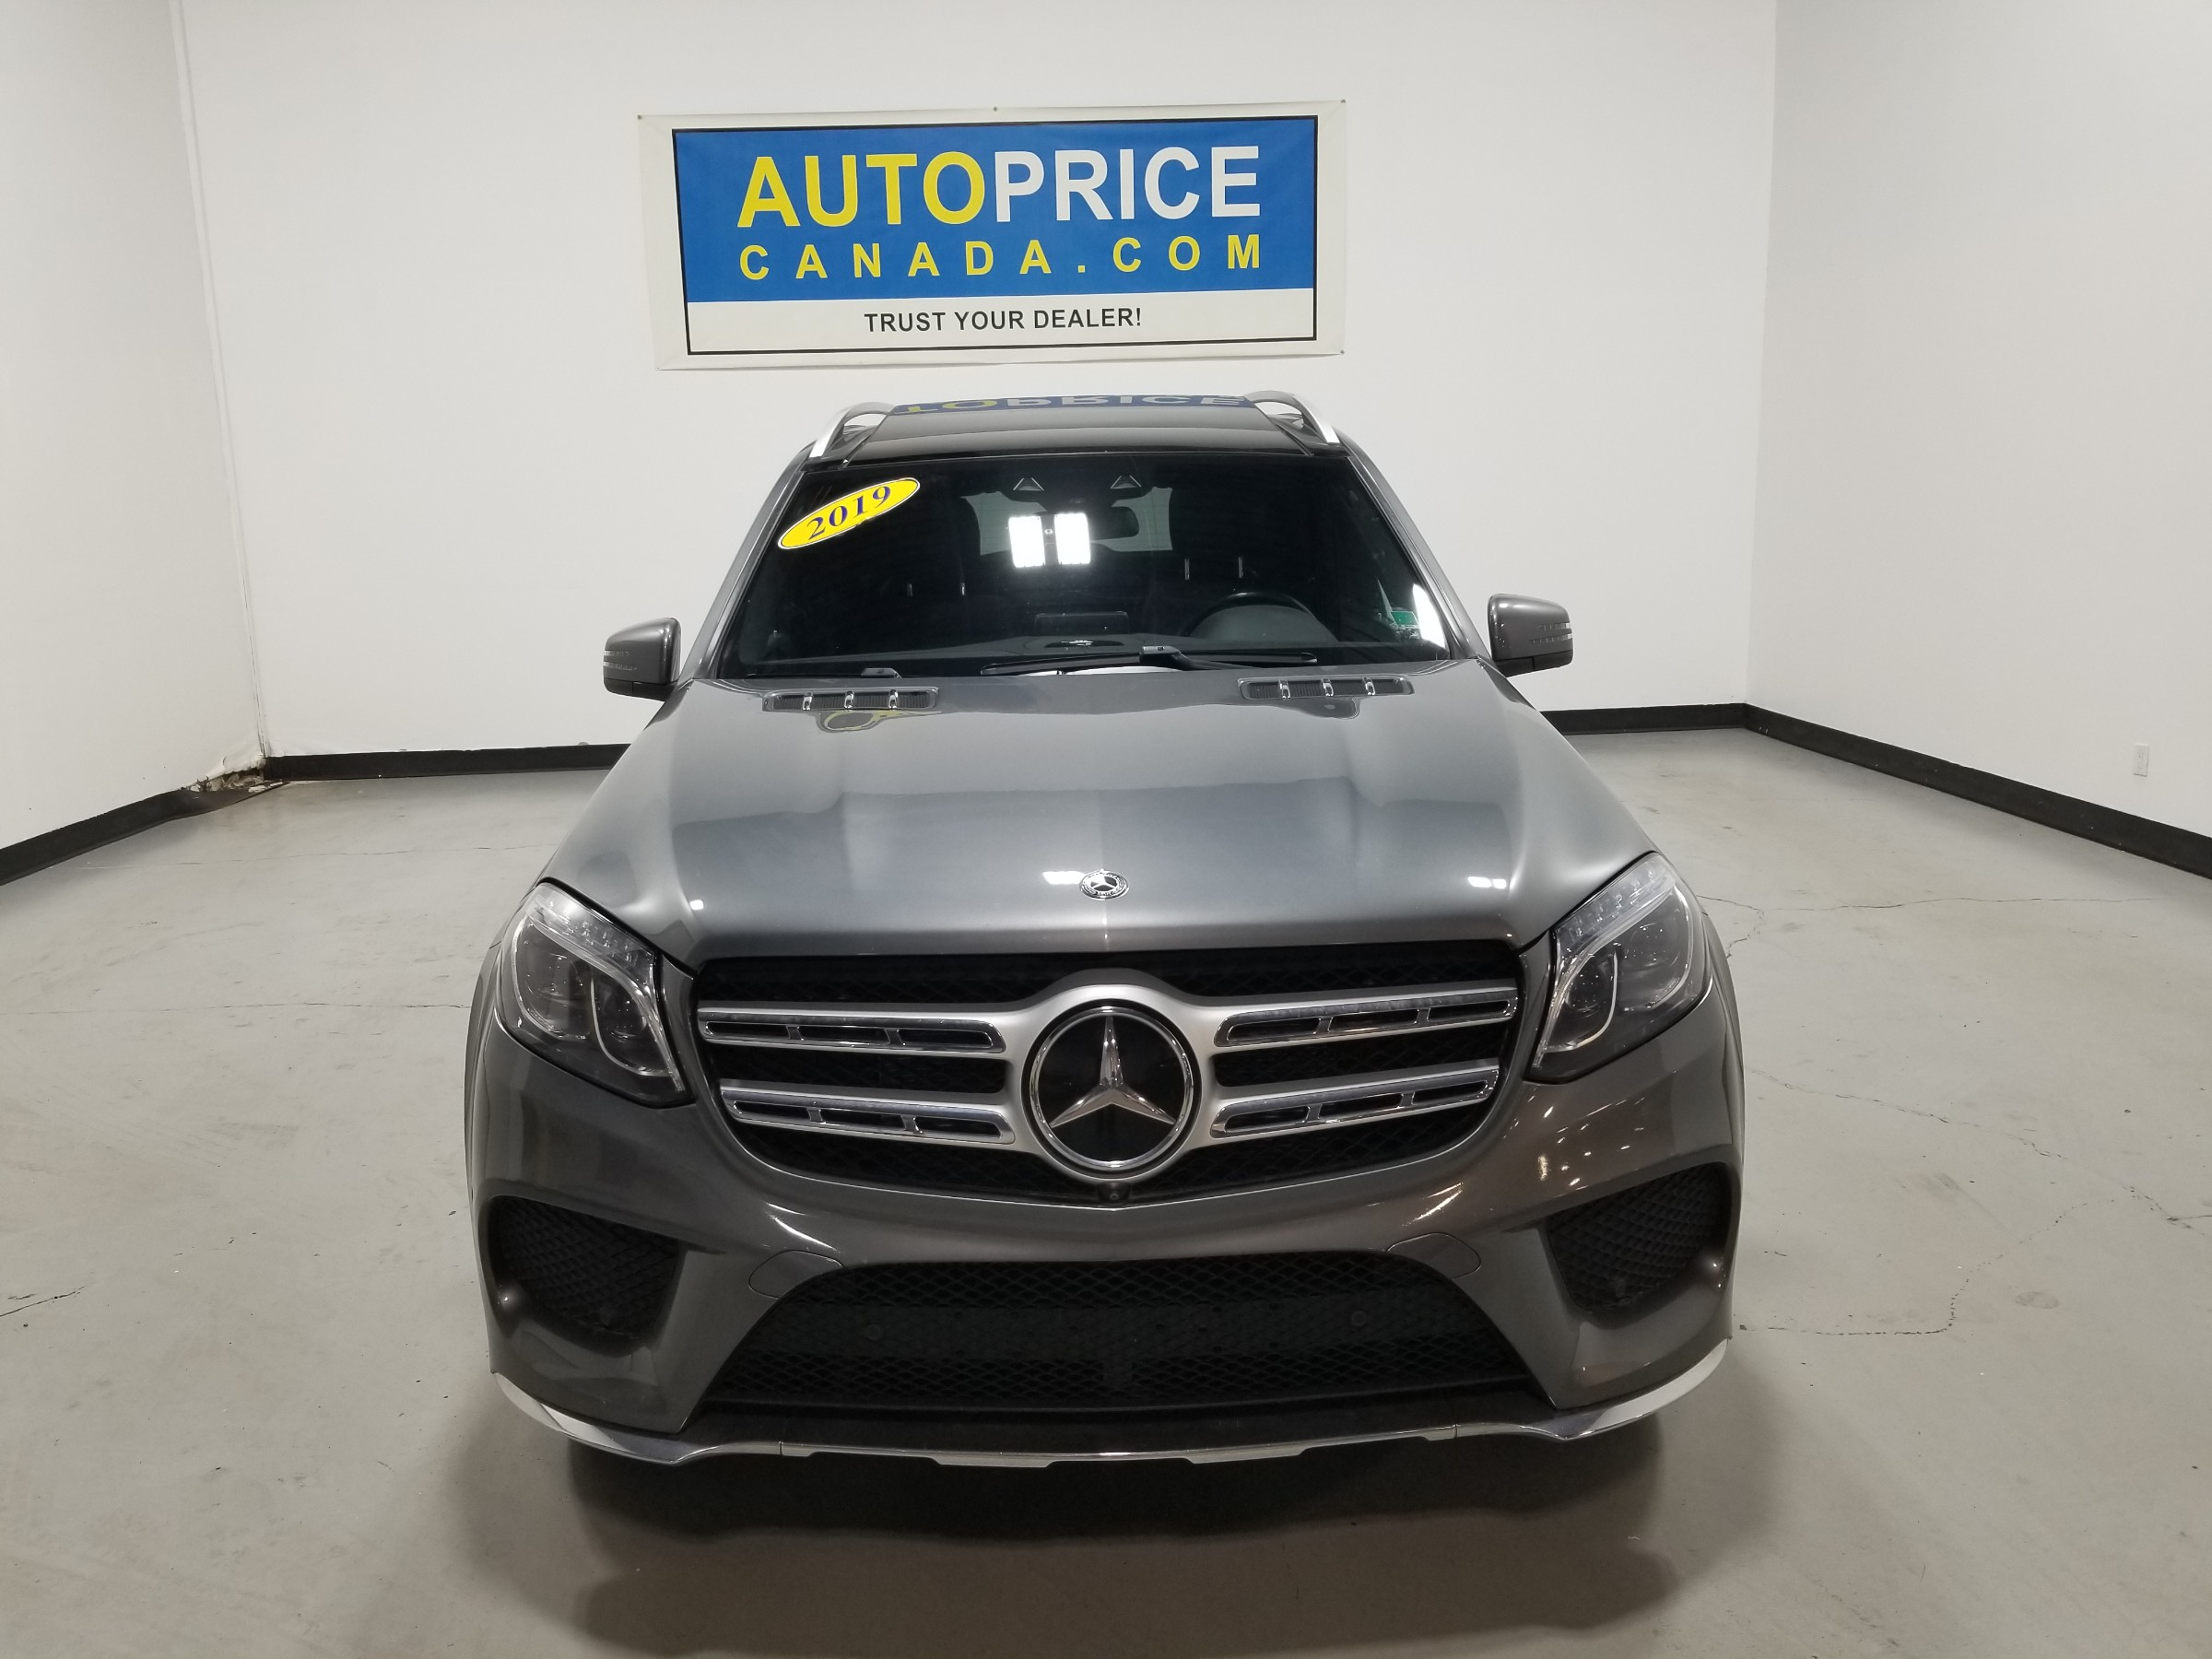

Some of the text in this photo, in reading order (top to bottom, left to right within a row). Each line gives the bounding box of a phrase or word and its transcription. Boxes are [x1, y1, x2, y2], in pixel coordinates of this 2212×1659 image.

[737, 146, 1260, 228] AUTOPRICE
[739, 234, 1260, 280] CANADA.COM
[864, 307, 1142, 332] TRUST YOUR DEALER!
[806, 486, 891, 541] 2019
